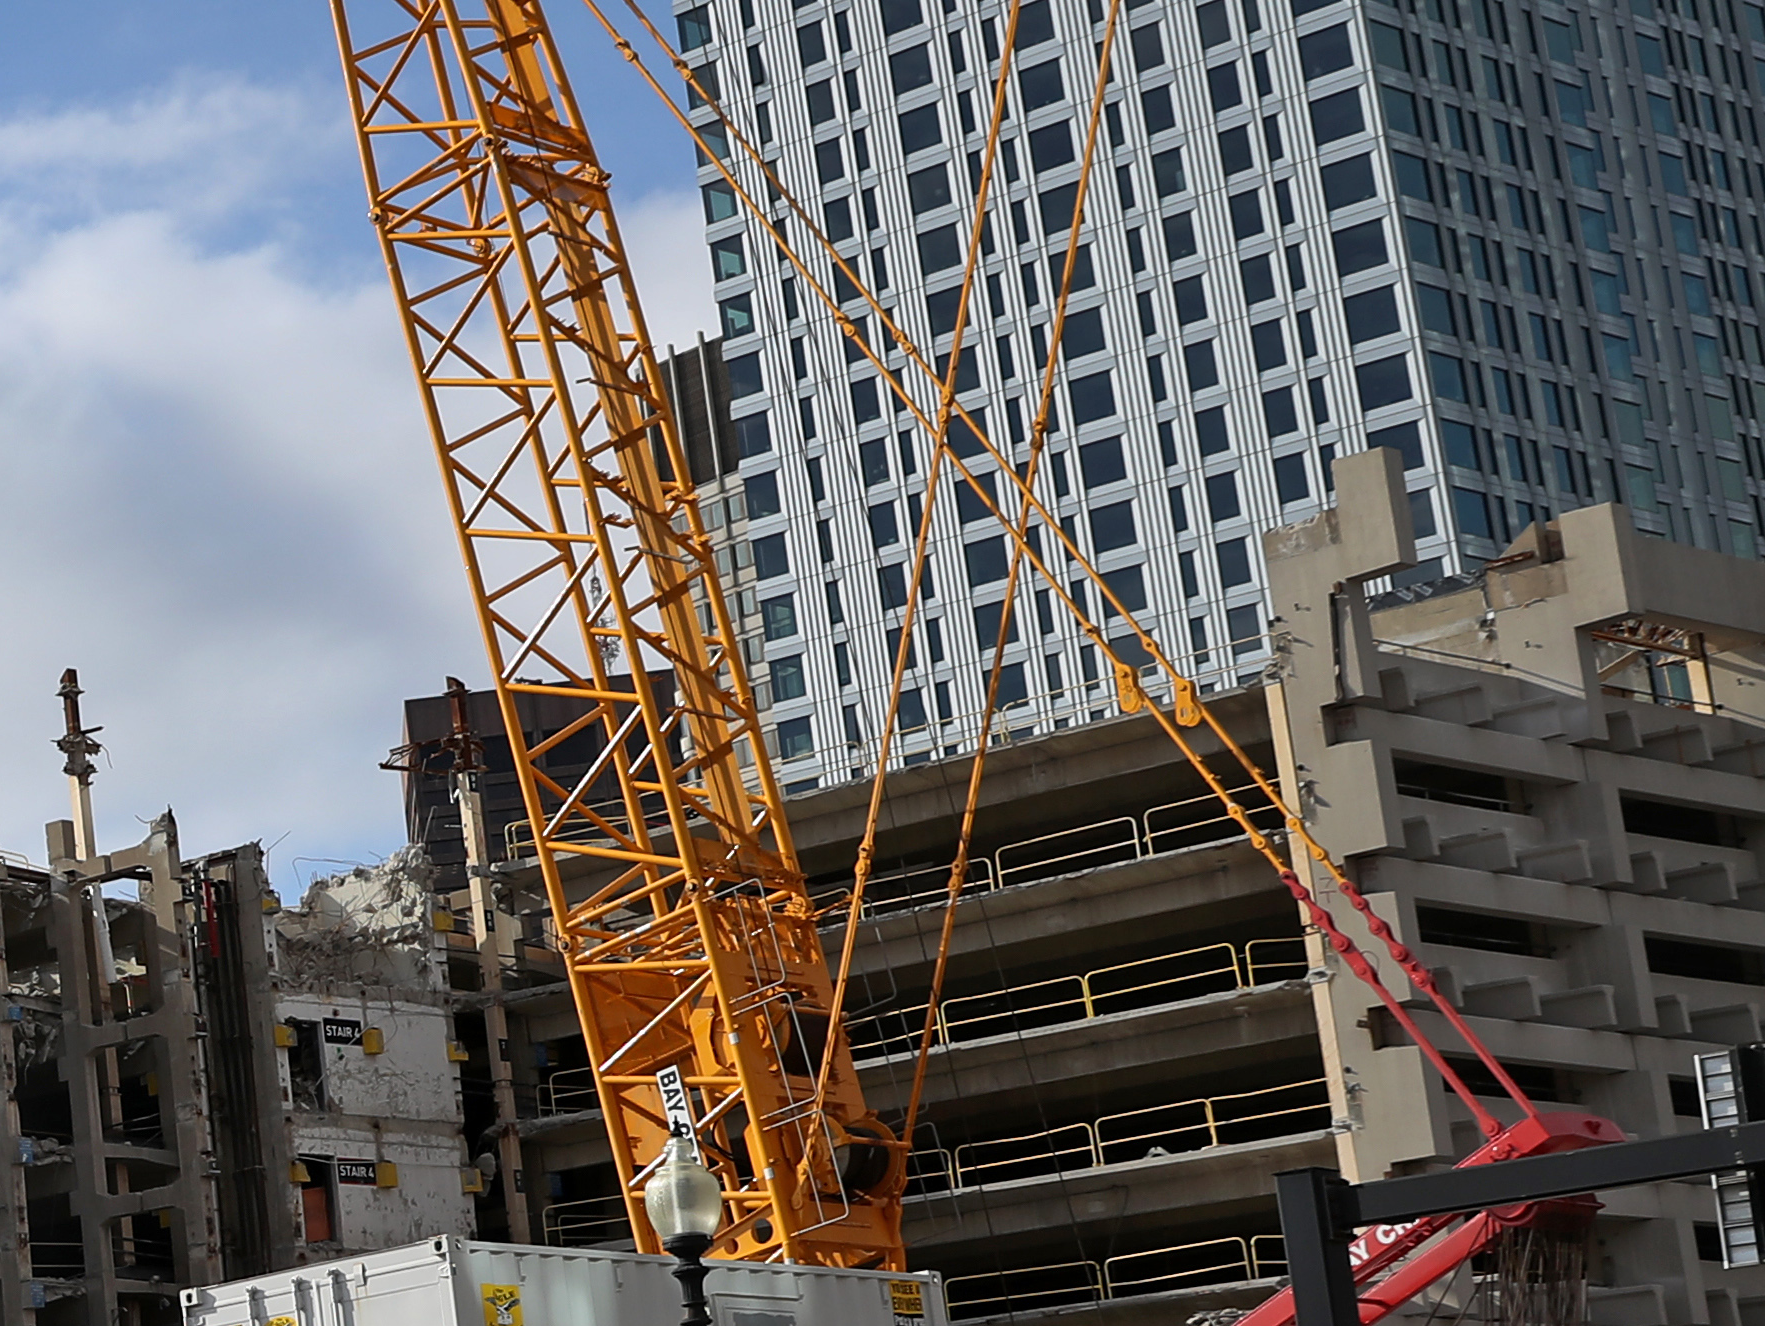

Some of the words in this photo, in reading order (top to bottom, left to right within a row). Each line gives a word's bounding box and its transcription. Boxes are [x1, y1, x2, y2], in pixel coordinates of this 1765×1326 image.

[326, 1025, 352, 1037] STAIR
[660, 1069, 685, 1112] BAY
[339, 1165, 367, 1177] STAIR
[367, 1167, 375, 1178] 4
